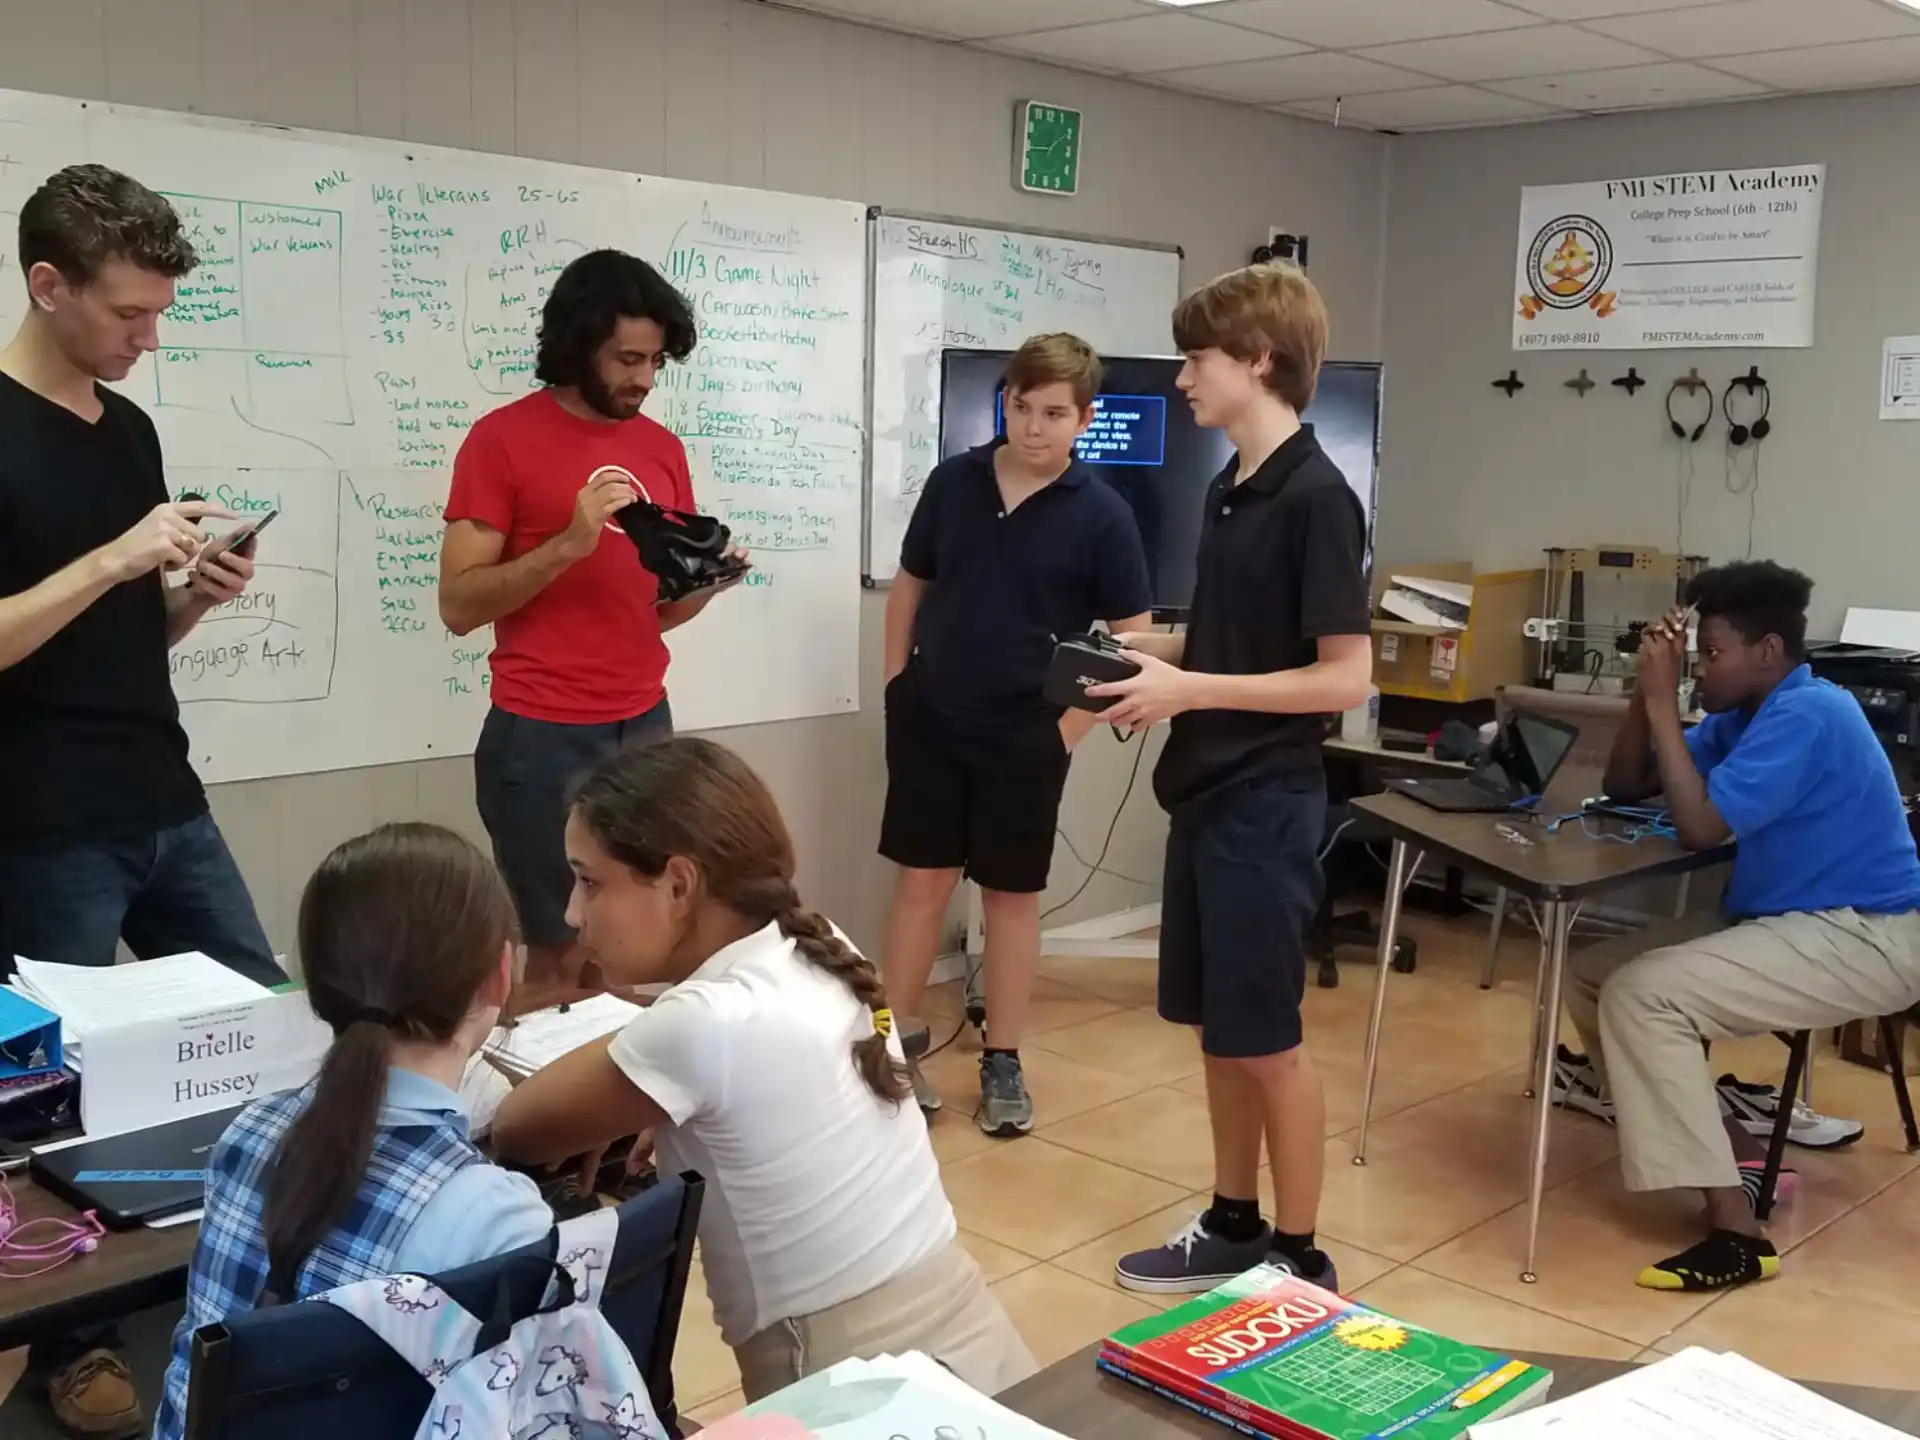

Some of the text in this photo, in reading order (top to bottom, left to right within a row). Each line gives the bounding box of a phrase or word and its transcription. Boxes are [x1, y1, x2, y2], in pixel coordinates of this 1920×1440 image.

[1047, 110, 1054, 122] 12
[1060, 113, 1064, 124] 1
[1067, 128, 1072, 139] 2
[1032, 174, 1036, 184] 7
[1653, 174, 1716, 196] STEM
[1724, 170, 1820, 193] Academy
[372, 184, 404, 203] War
[417, 183, 491, 204] Veterans
[1630, 200, 1797, 221] College Prep School (6th 12th)
[500, 220, 547, 255] RRH
[771, 264, 821, 299] Night
[908, 261, 984, 304] Monologue
[1519, 332, 1600, 347] (407) 490-8810
[1642, 331, 1765, 342] FMISTEMAcademy.com
[1111, 412, 1140, 420] remote
[771, 418, 800, 448] Day
[1092, 442, 1117, 450] device
[216, 484, 282, 513] School
[367, 493, 444, 520] Research
[170, 640, 249, 681] anguage
[444, 677, 472, 697] The
[177, 1032, 256, 1063] Brielle
[173, 1072, 259, 1103] Hussey
[1186, 1296, 1330, 1367] SUDOKU
